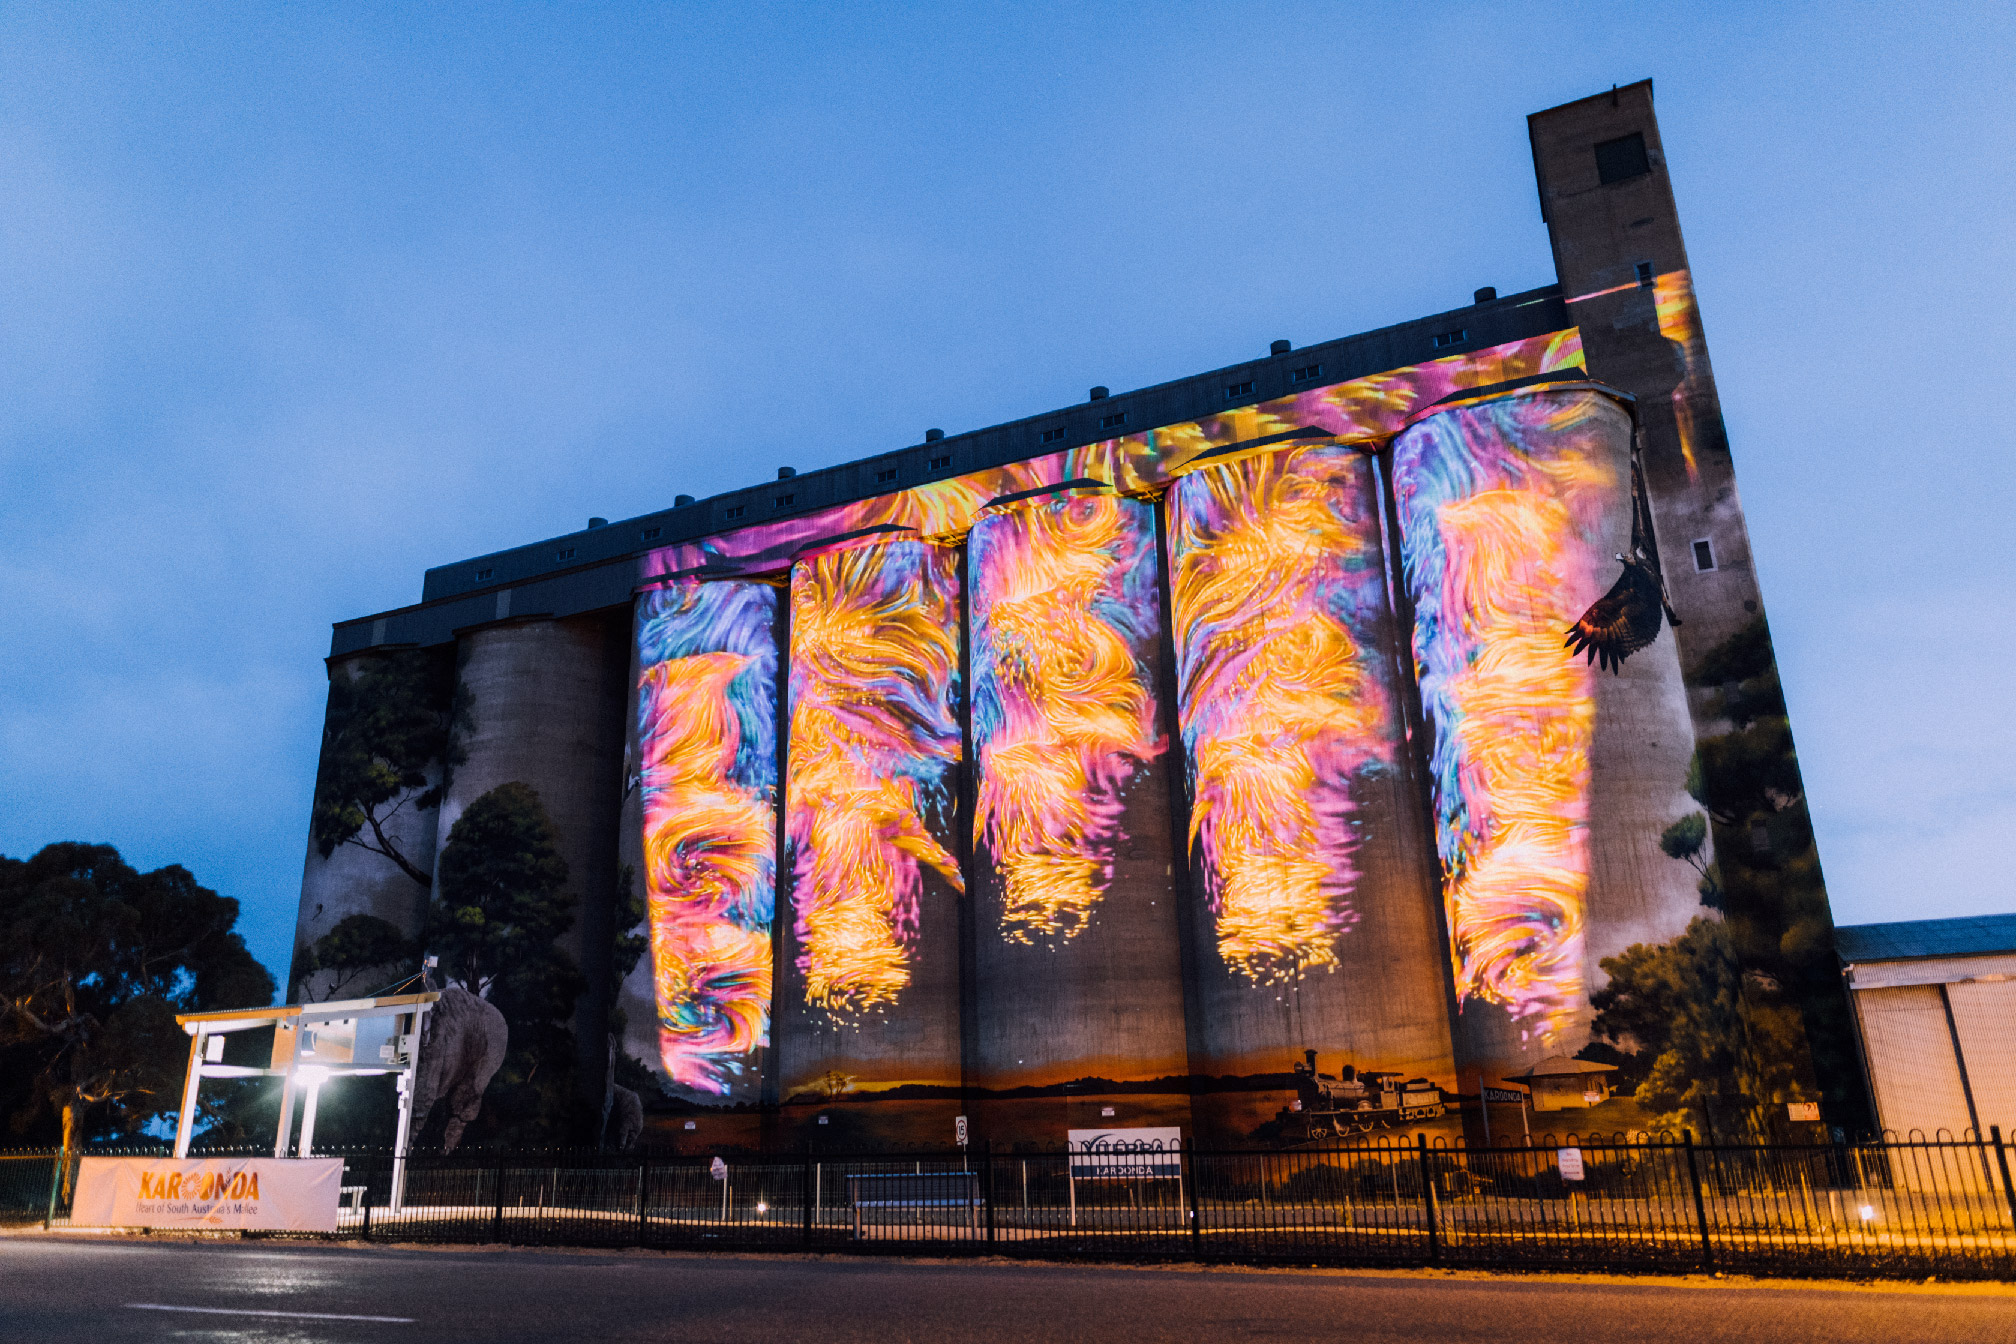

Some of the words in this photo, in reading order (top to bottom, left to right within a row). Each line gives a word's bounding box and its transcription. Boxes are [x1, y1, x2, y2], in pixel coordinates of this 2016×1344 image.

[138, 1171, 260, 1201] KAROONDA
[135, 1202, 155, 1214] Heart
[156, 1202, 165, 1214] of
[167, 1202, 189, 1214] South
[191, 1202, 231, 1214] Austrlia's
[233, 1202, 258, 1215] Mallee
